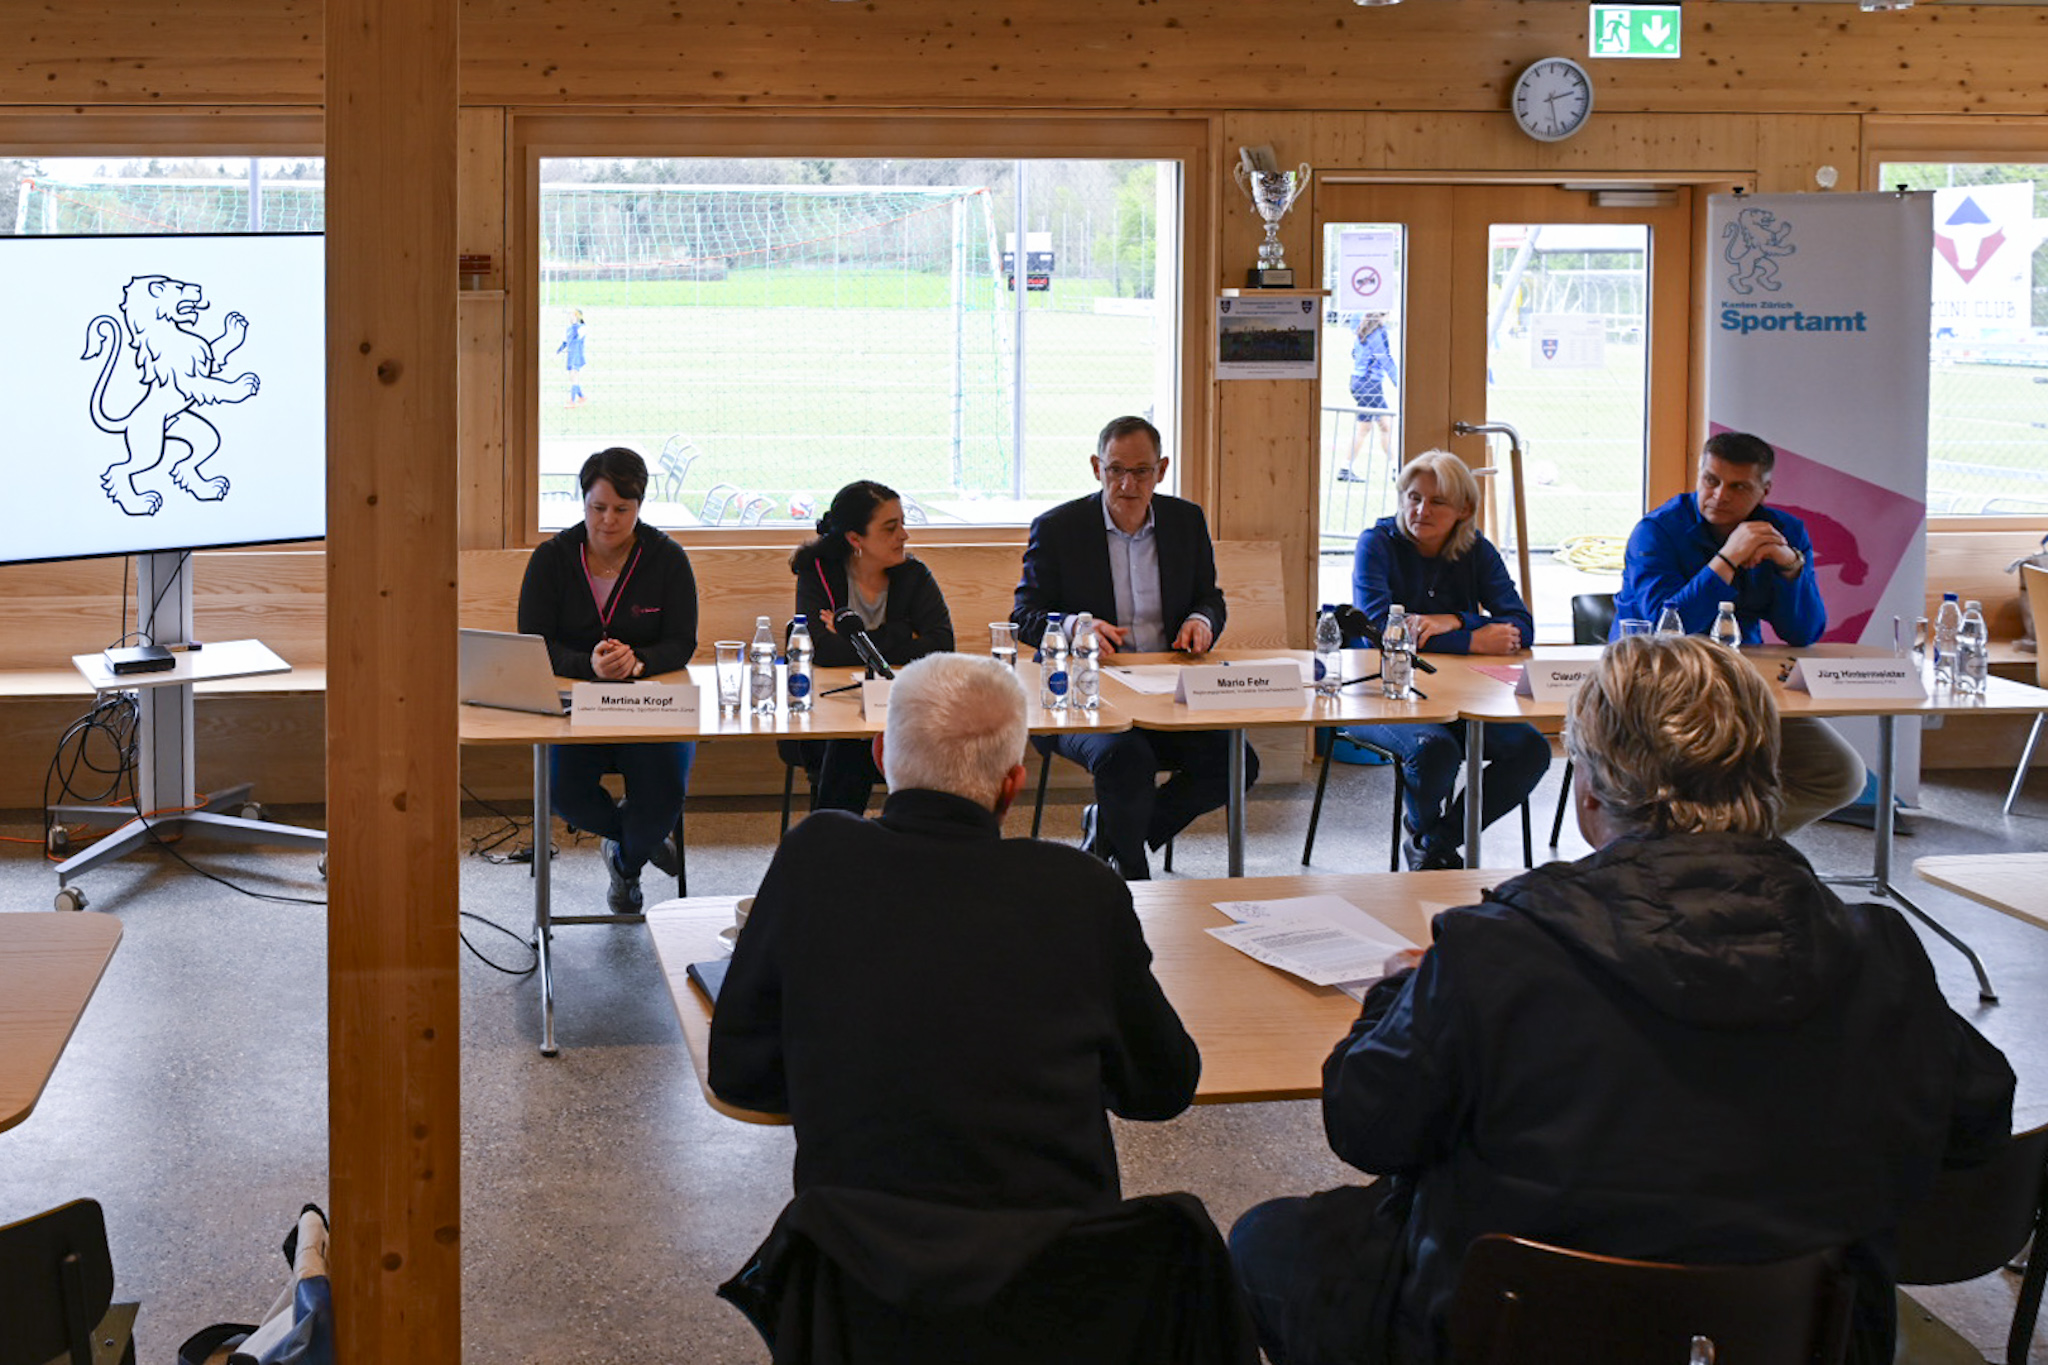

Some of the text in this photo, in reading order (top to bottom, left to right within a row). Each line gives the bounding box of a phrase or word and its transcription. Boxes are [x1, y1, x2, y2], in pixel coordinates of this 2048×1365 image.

[1721, 301, 1794, 309] Kanton Zürich
[1932, 301, 1967, 317] UNI
[1720, 309, 1867, 335] Sportamt
[1818, 670, 1839, 680] Jürg
[1217, 677, 1270, 687] Mario Fehr
[601, 696, 673, 707] Martina Kropf
